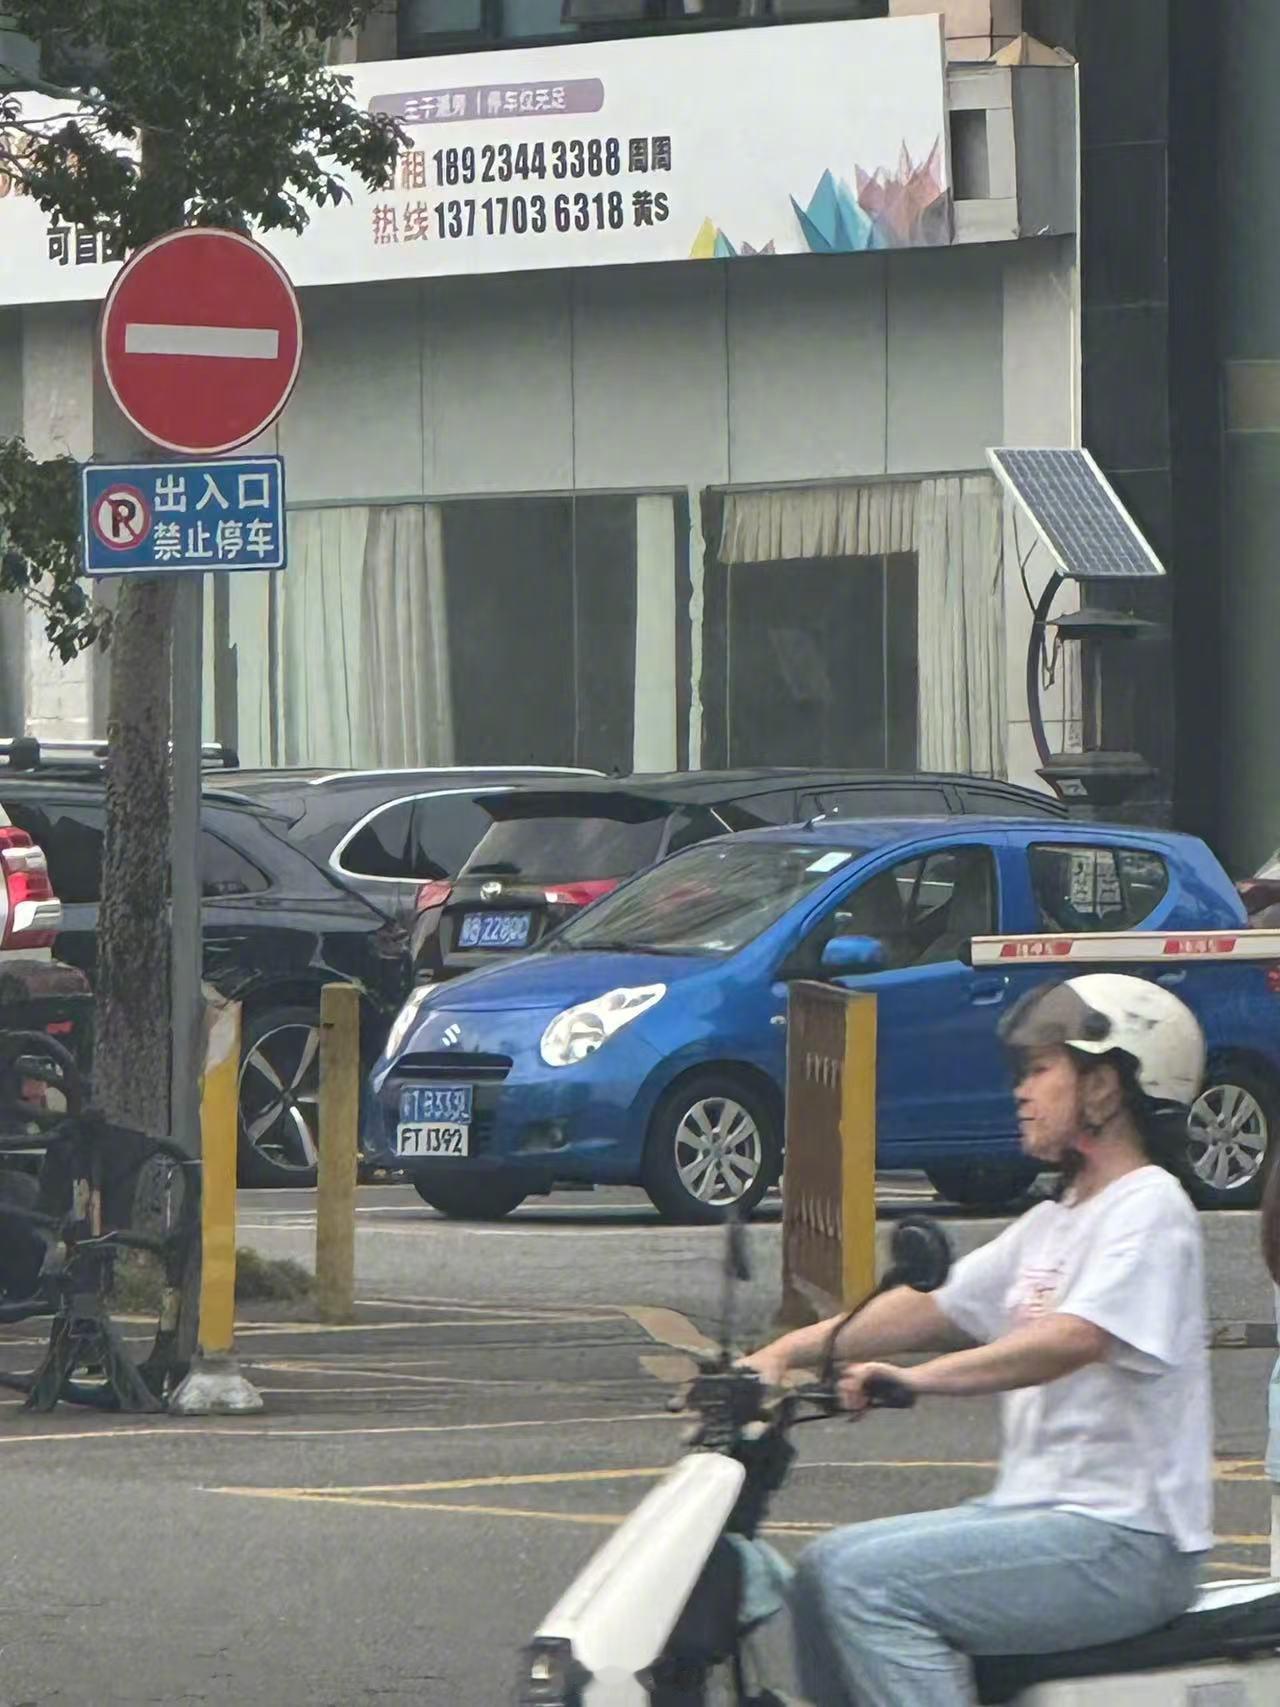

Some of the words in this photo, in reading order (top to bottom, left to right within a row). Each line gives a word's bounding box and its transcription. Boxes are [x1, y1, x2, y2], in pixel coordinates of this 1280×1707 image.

[432, 147, 475, 187] 189
[481, 142, 547, 183] 2344
[552, 138, 620, 179] 3388
[371, 201, 430, 244] 热线
[434, 200, 476, 239] 137
[482, 194, 547, 235] 1703
[554, 191, 623, 232] 6318
[153, 473, 271, 512] 出入口
[153, 518, 274, 560] 禁止停车
